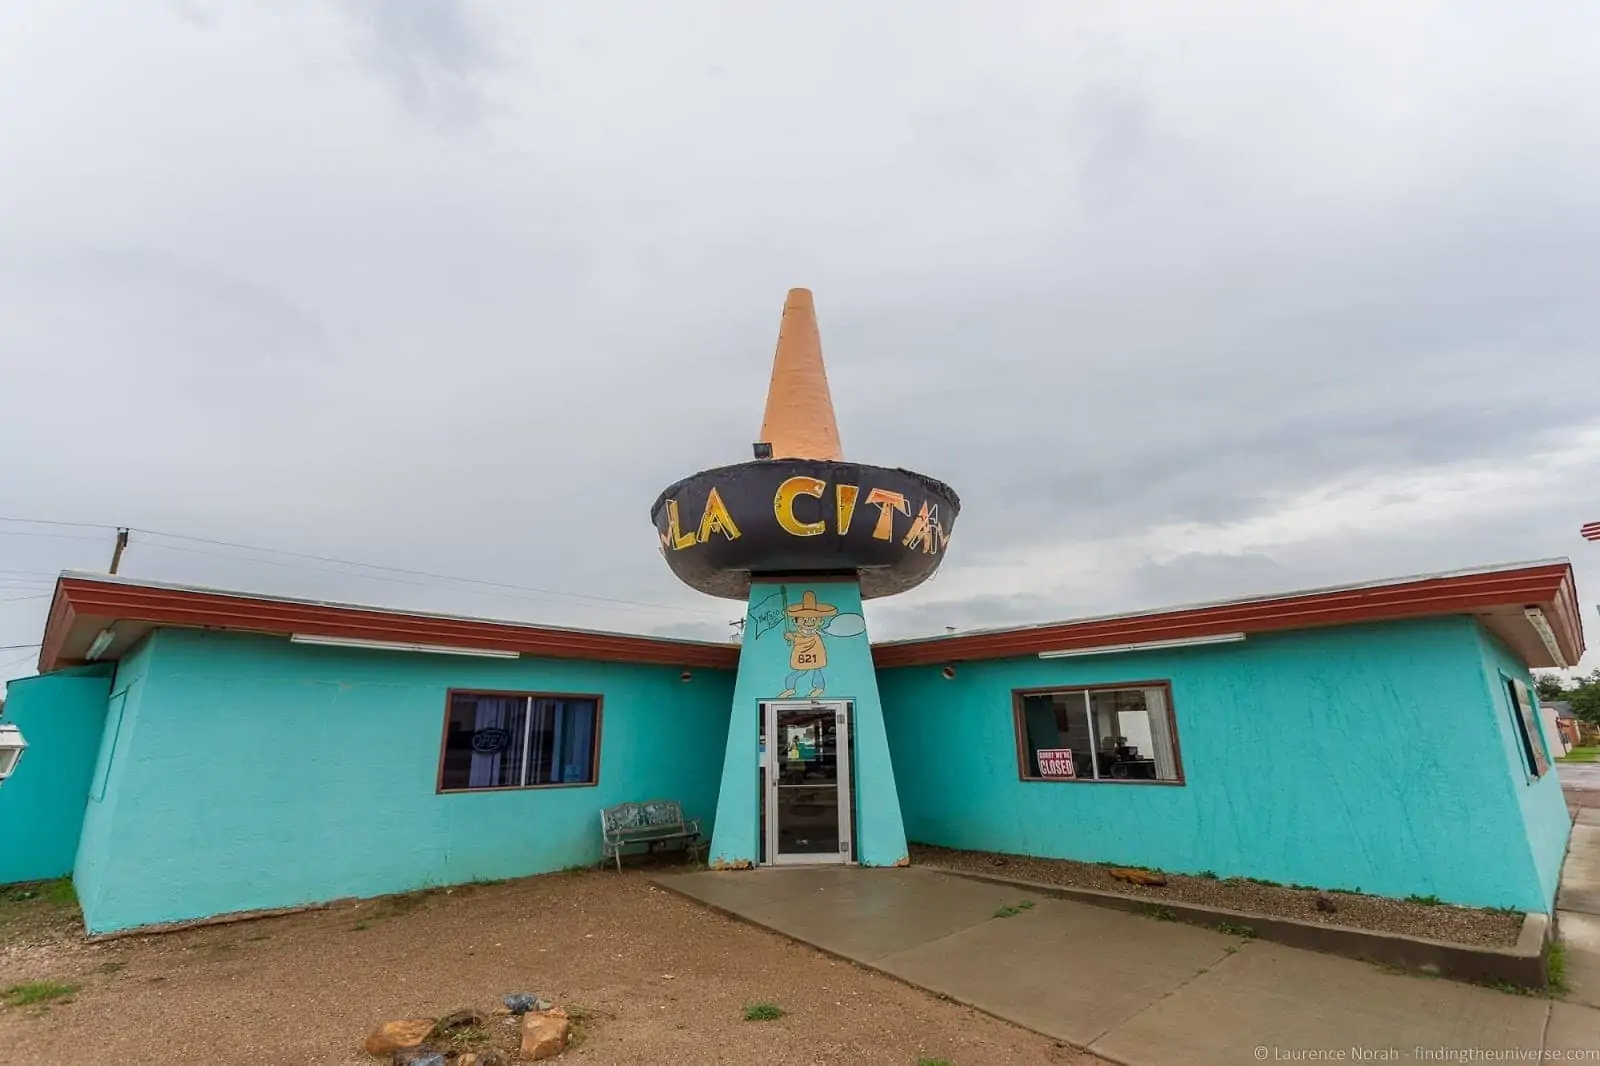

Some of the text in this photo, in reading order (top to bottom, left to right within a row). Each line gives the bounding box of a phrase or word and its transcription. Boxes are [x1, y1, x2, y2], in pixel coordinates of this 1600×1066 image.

[665, 475, 939, 555] LA CITA
[1040, 759, 1073, 775] CLOSED
